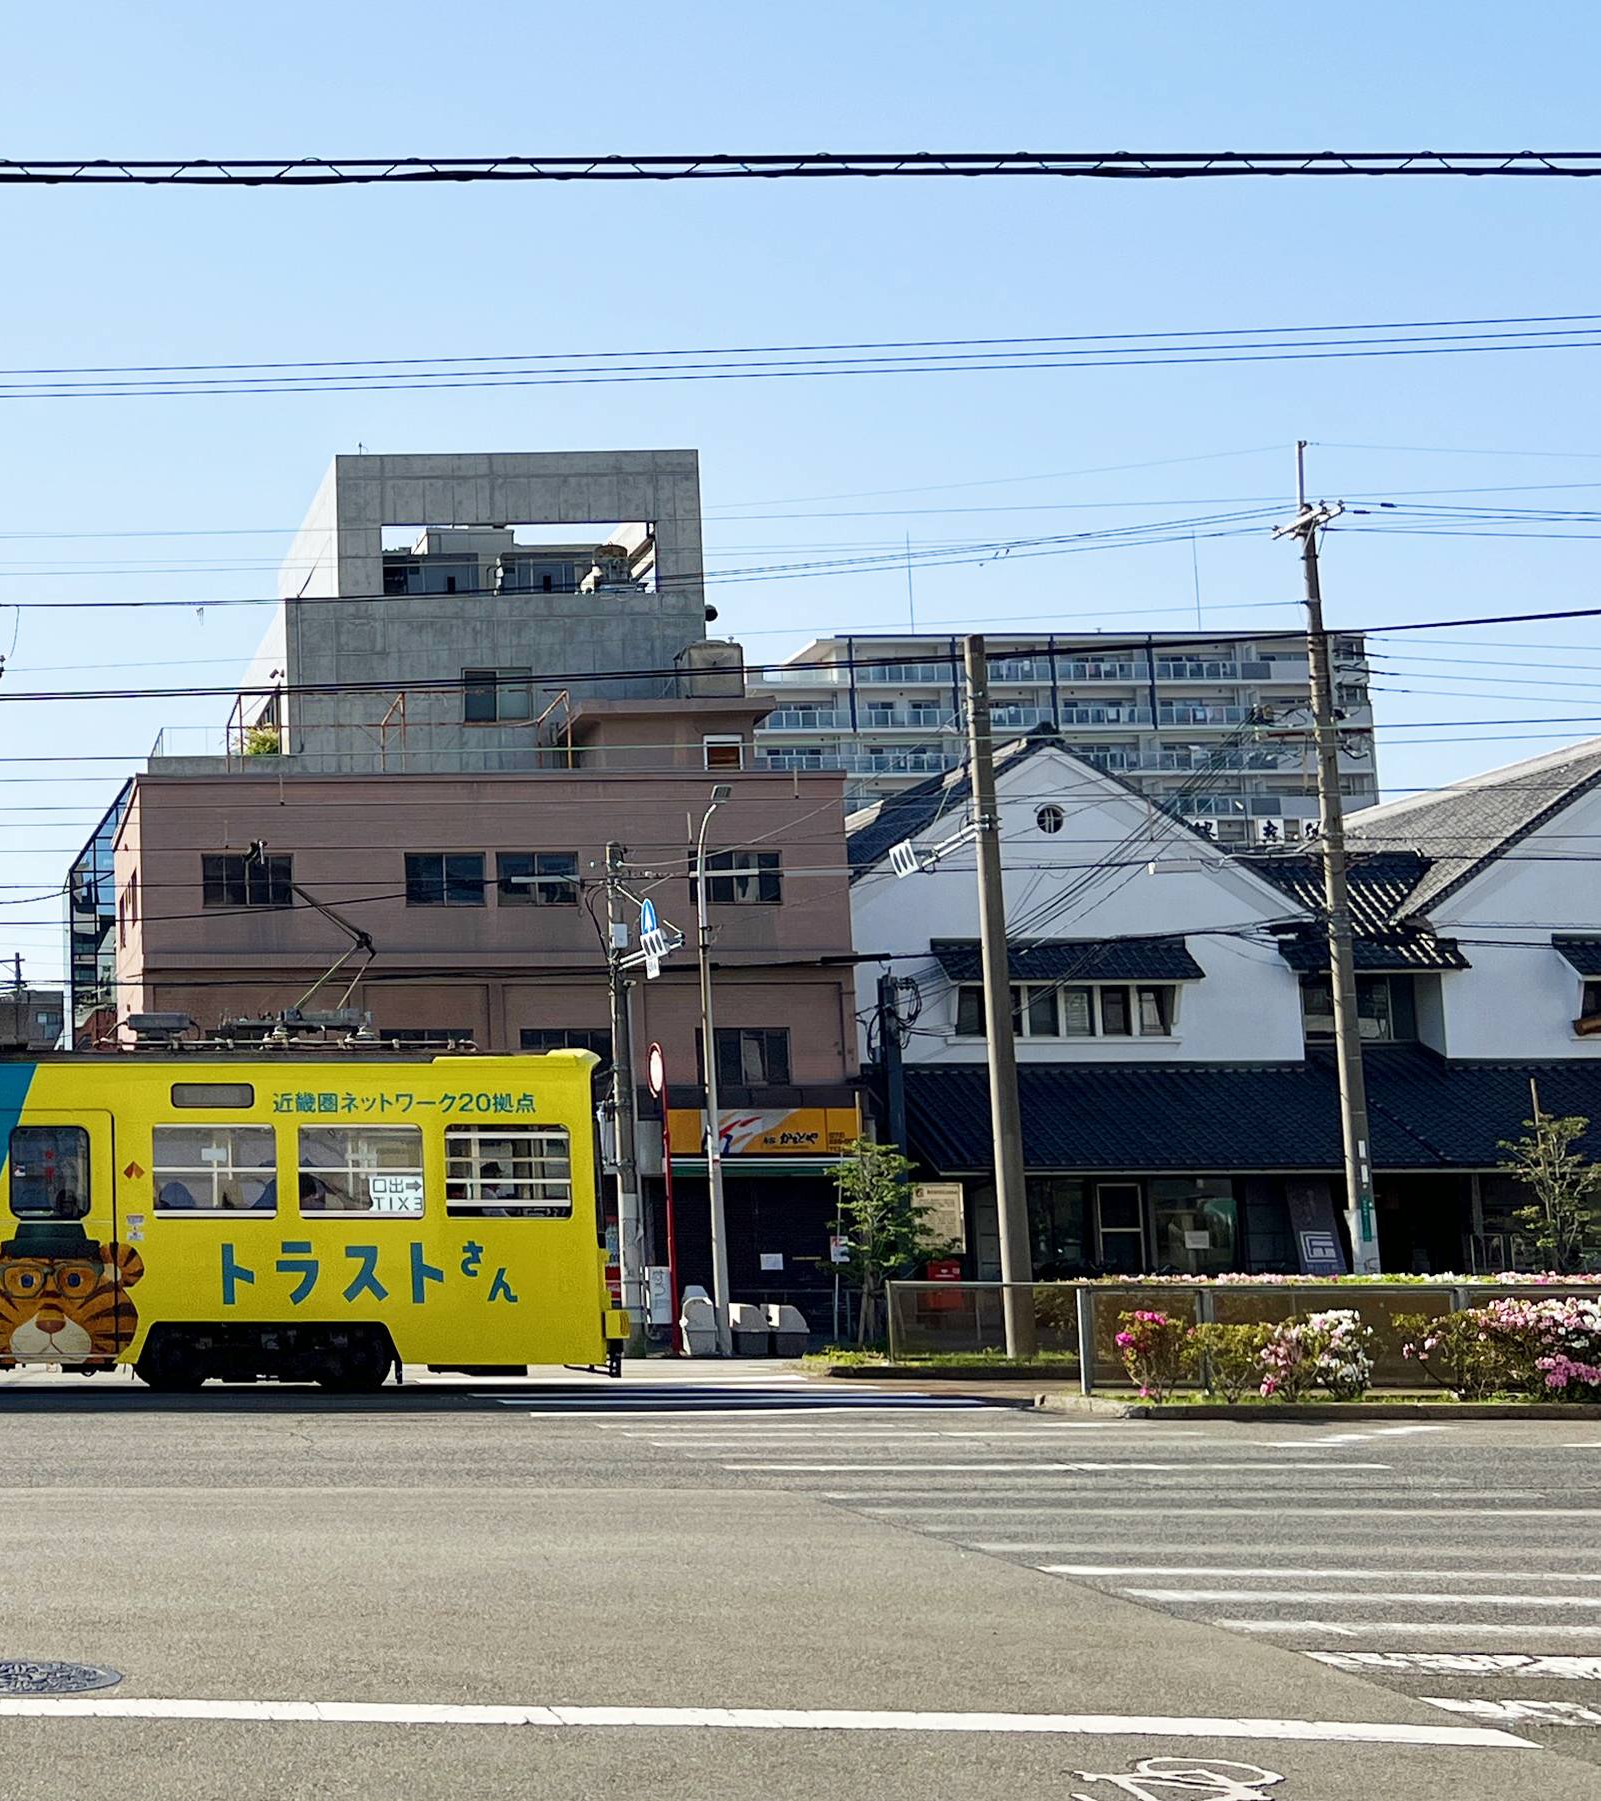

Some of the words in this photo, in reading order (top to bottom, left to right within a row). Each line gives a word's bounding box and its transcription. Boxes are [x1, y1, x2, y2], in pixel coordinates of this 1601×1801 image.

[273, 1092, 537, 1113] 近畿圏ネットワーク20拠点
[221, 1240, 518, 1306] トラストさん
